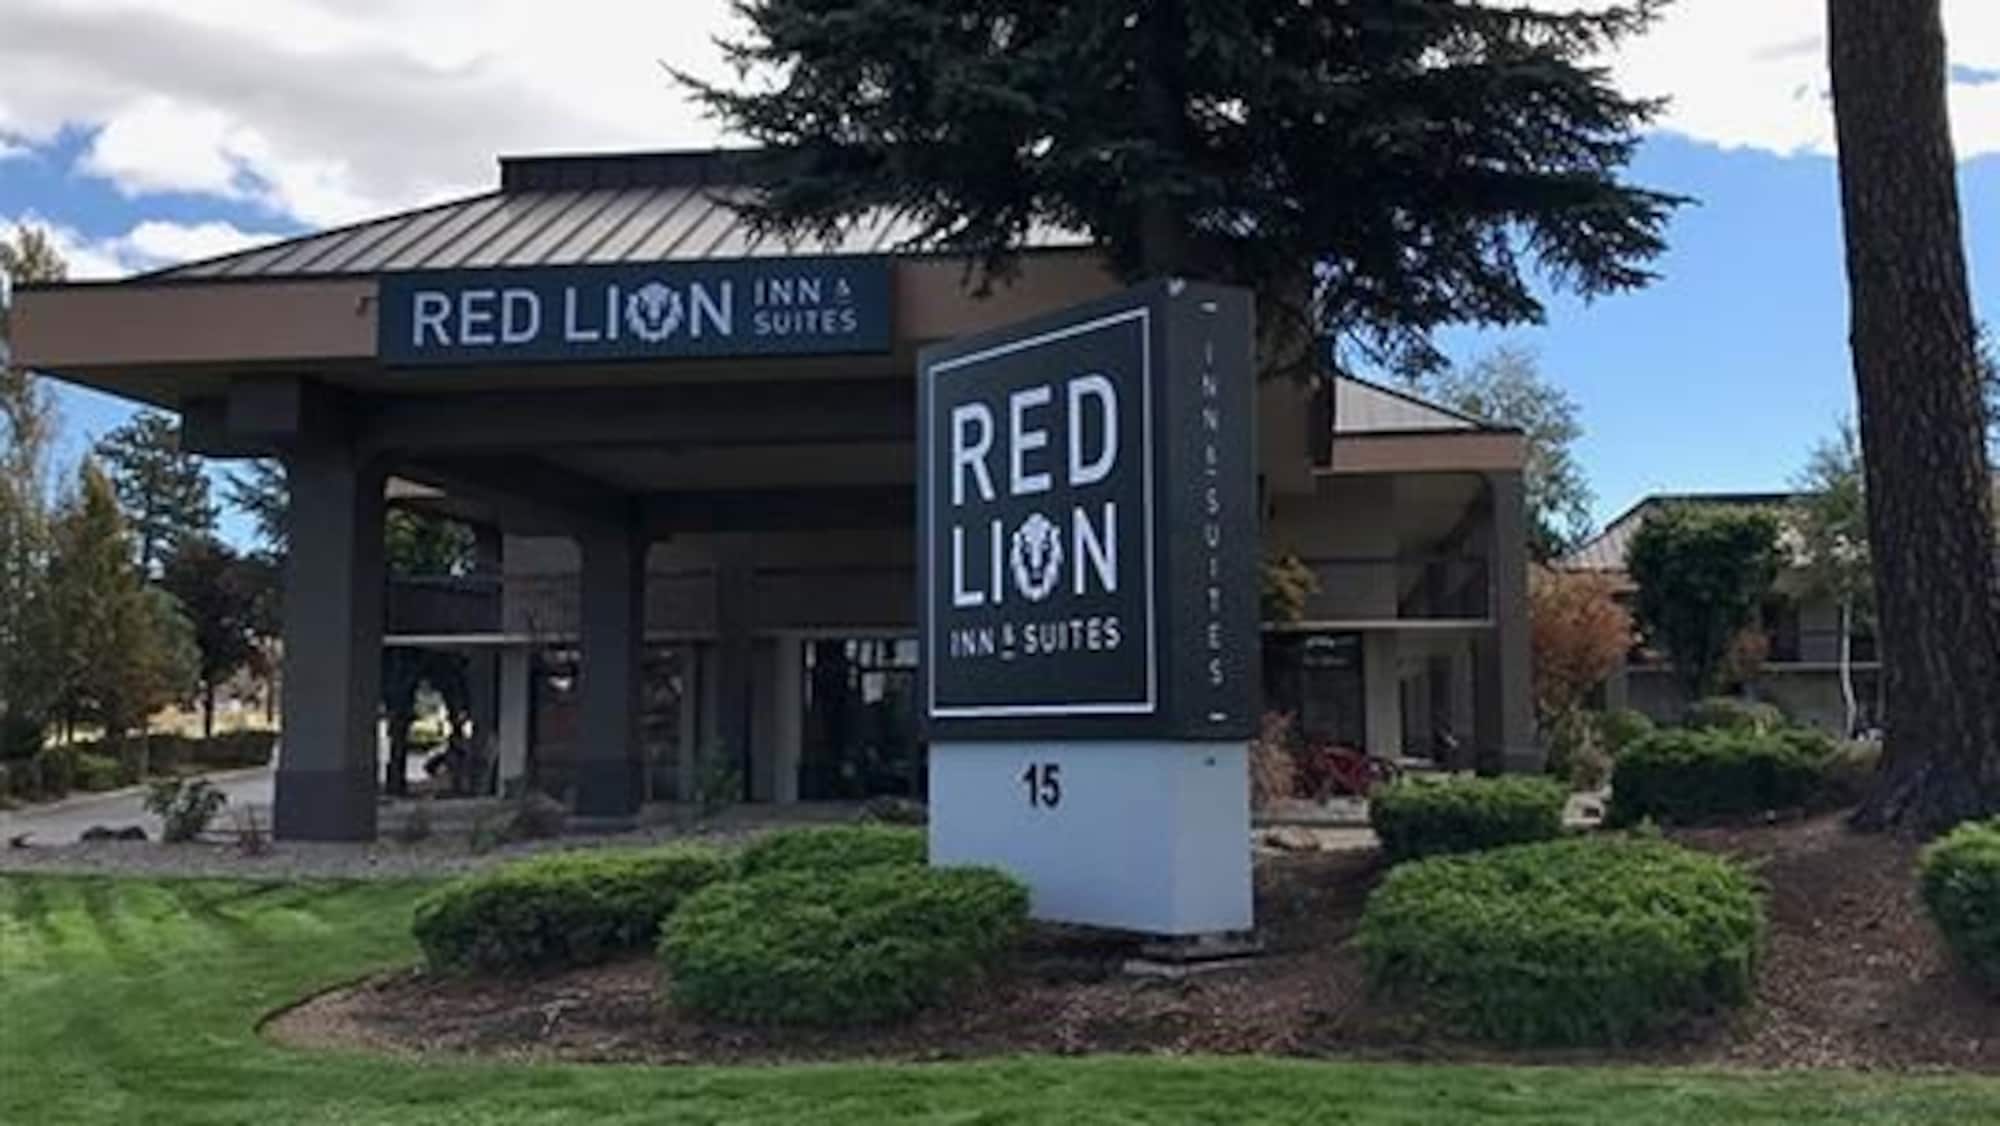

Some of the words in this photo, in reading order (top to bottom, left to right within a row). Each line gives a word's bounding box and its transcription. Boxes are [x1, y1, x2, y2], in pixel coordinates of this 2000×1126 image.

[413, 288, 541, 347] RED
[565, 279, 733, 342] LION
[754, 277, 821, 307] INN
[754, 308, 857, 336] SUITES
[1202, 342, 1217, 433] INN
[951, 373, 1119, 506] RED
[953, 501, 1118, 607] LION
[1204, 487, 1223, 685] SUITES
[950, 627, 995, 658] INN
[1024, 617, 1121, 653] SUITES
[1022, 761, 1061, 808] 15
